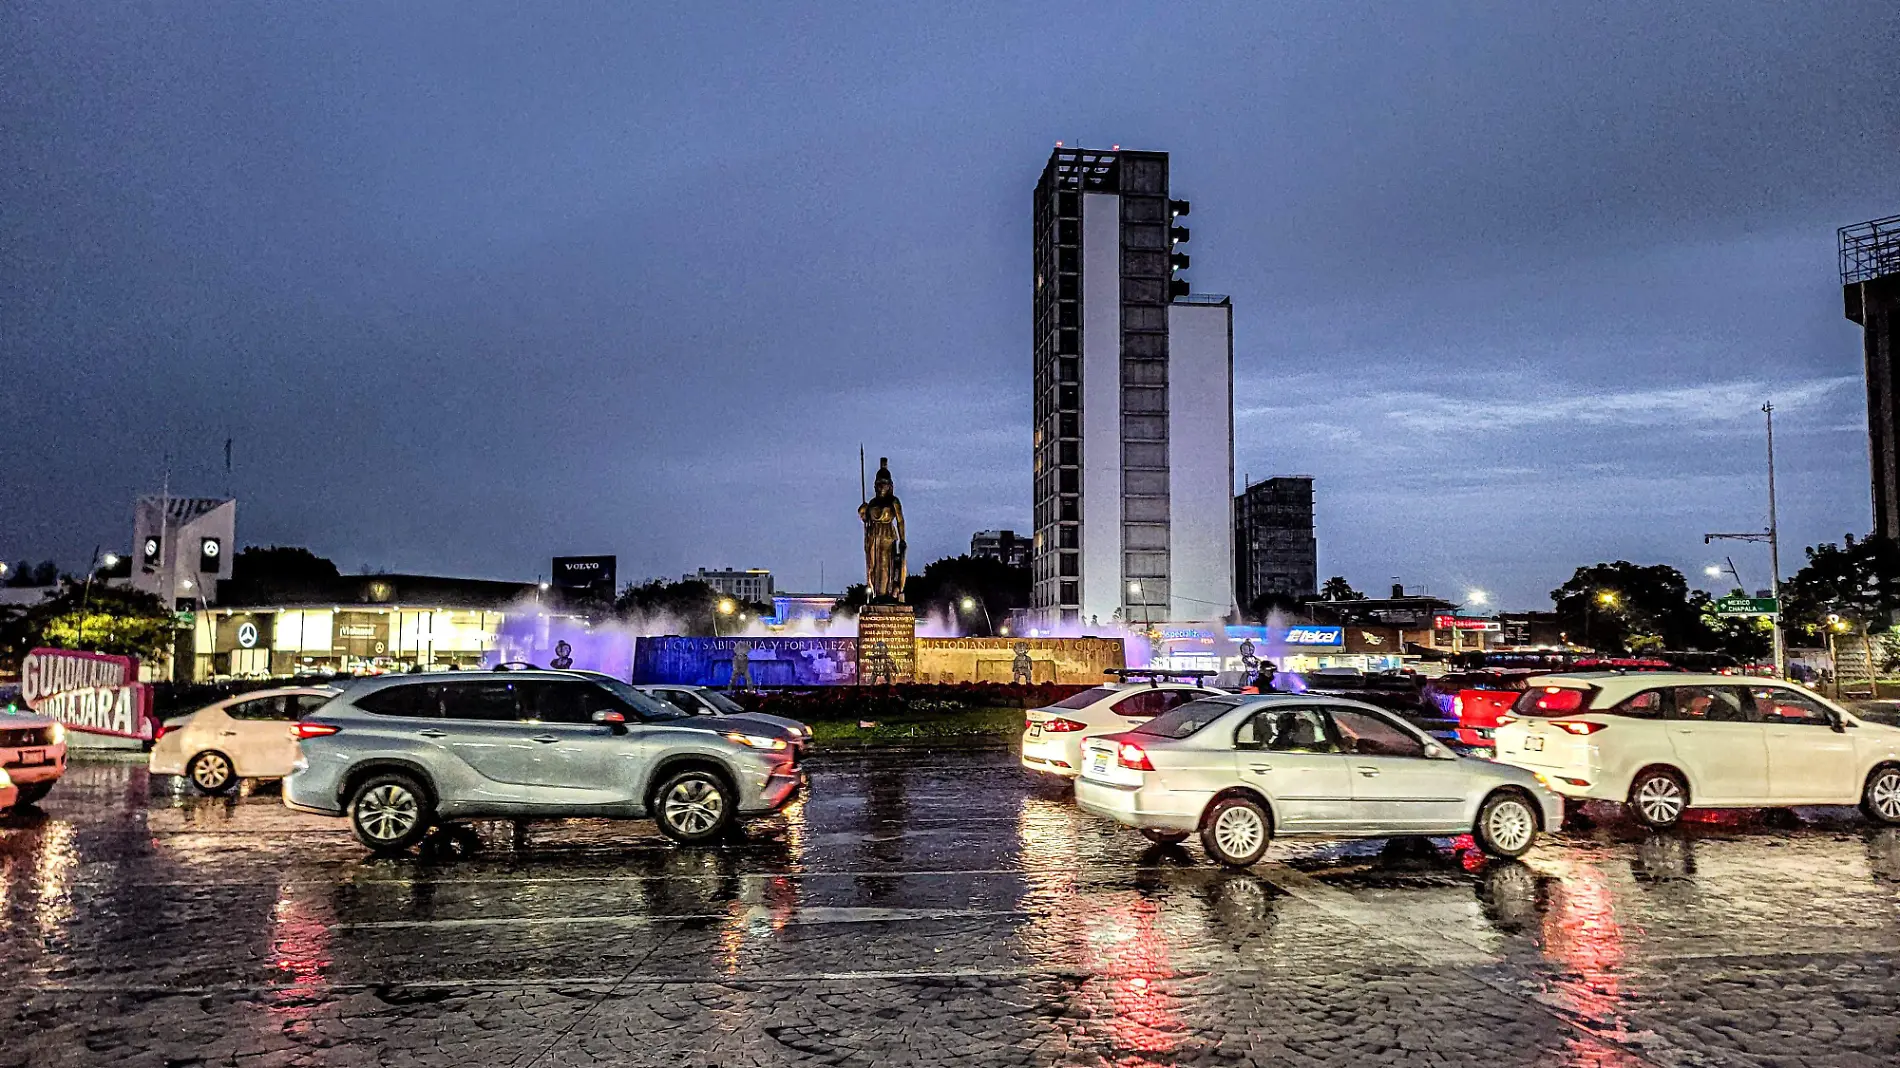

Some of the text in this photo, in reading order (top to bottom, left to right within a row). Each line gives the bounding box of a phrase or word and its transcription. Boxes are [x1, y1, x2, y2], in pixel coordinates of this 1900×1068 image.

[1302, 630, 1338, 642] telcel
[703, 641, 766, 650] SABIDRIA
[784, 641, 855, 650] FORTALEZA
[1007, 642, 1033, 650] EA
[22, 653, 121, 701] GUADALAJARA
